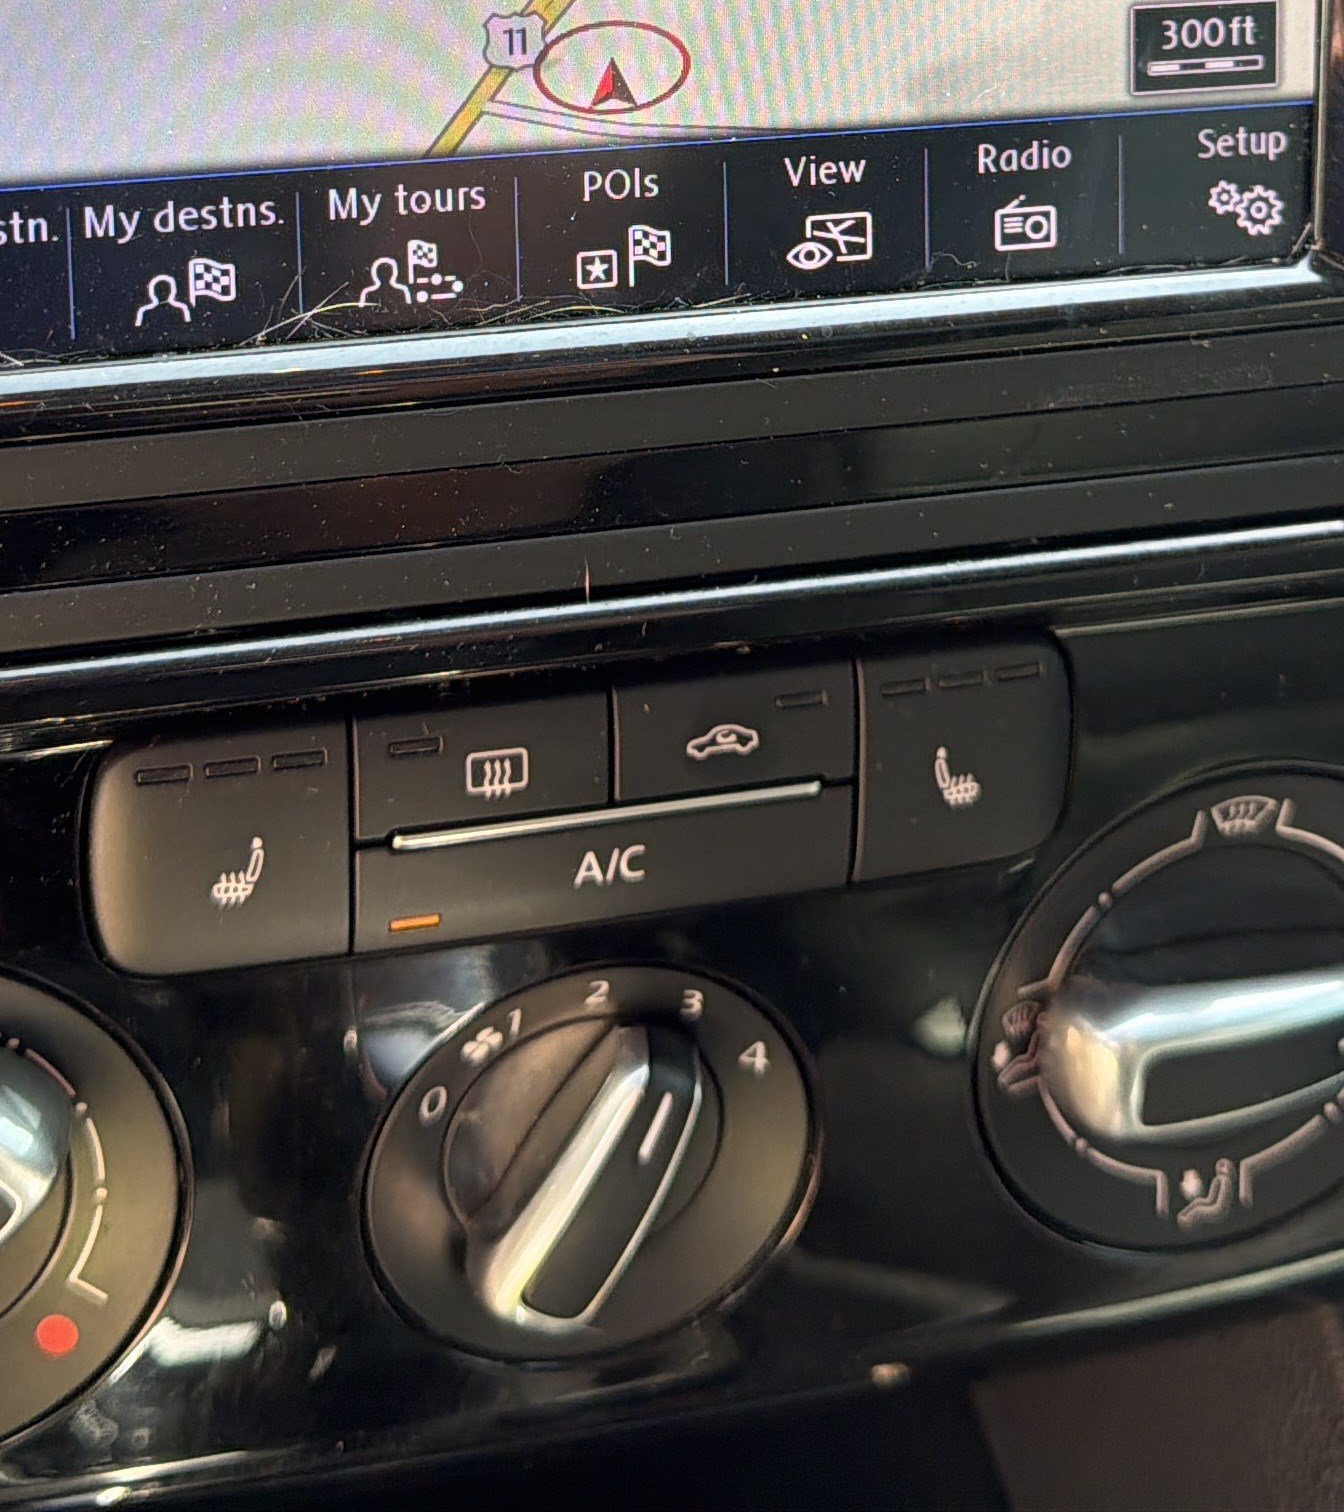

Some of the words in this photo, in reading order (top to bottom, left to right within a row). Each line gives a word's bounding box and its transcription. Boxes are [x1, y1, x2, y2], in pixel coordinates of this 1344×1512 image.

[503, 27, 528, 56] 11
[977, 139, 1072, 175] Radio
[1197, 126, 1288, 162] Setup
[582, 167, 659, 202] POIs
[784, 156, 866, 187] View
[83, 204, 141, 245] My
[153, 196, 285, 235] destns.
[327, 187, 382, 226] My
[395, 183, 487, 216] tours
[574, 844, 647, 888] A/C
[584, 979, 611, 1010] 2
[680, 989, 705, 1021] 3
[505, 1007, 522, 1038] 1
[738, 1041, 770, 1076] 4
[419, 1085, 448, 1123] 0
